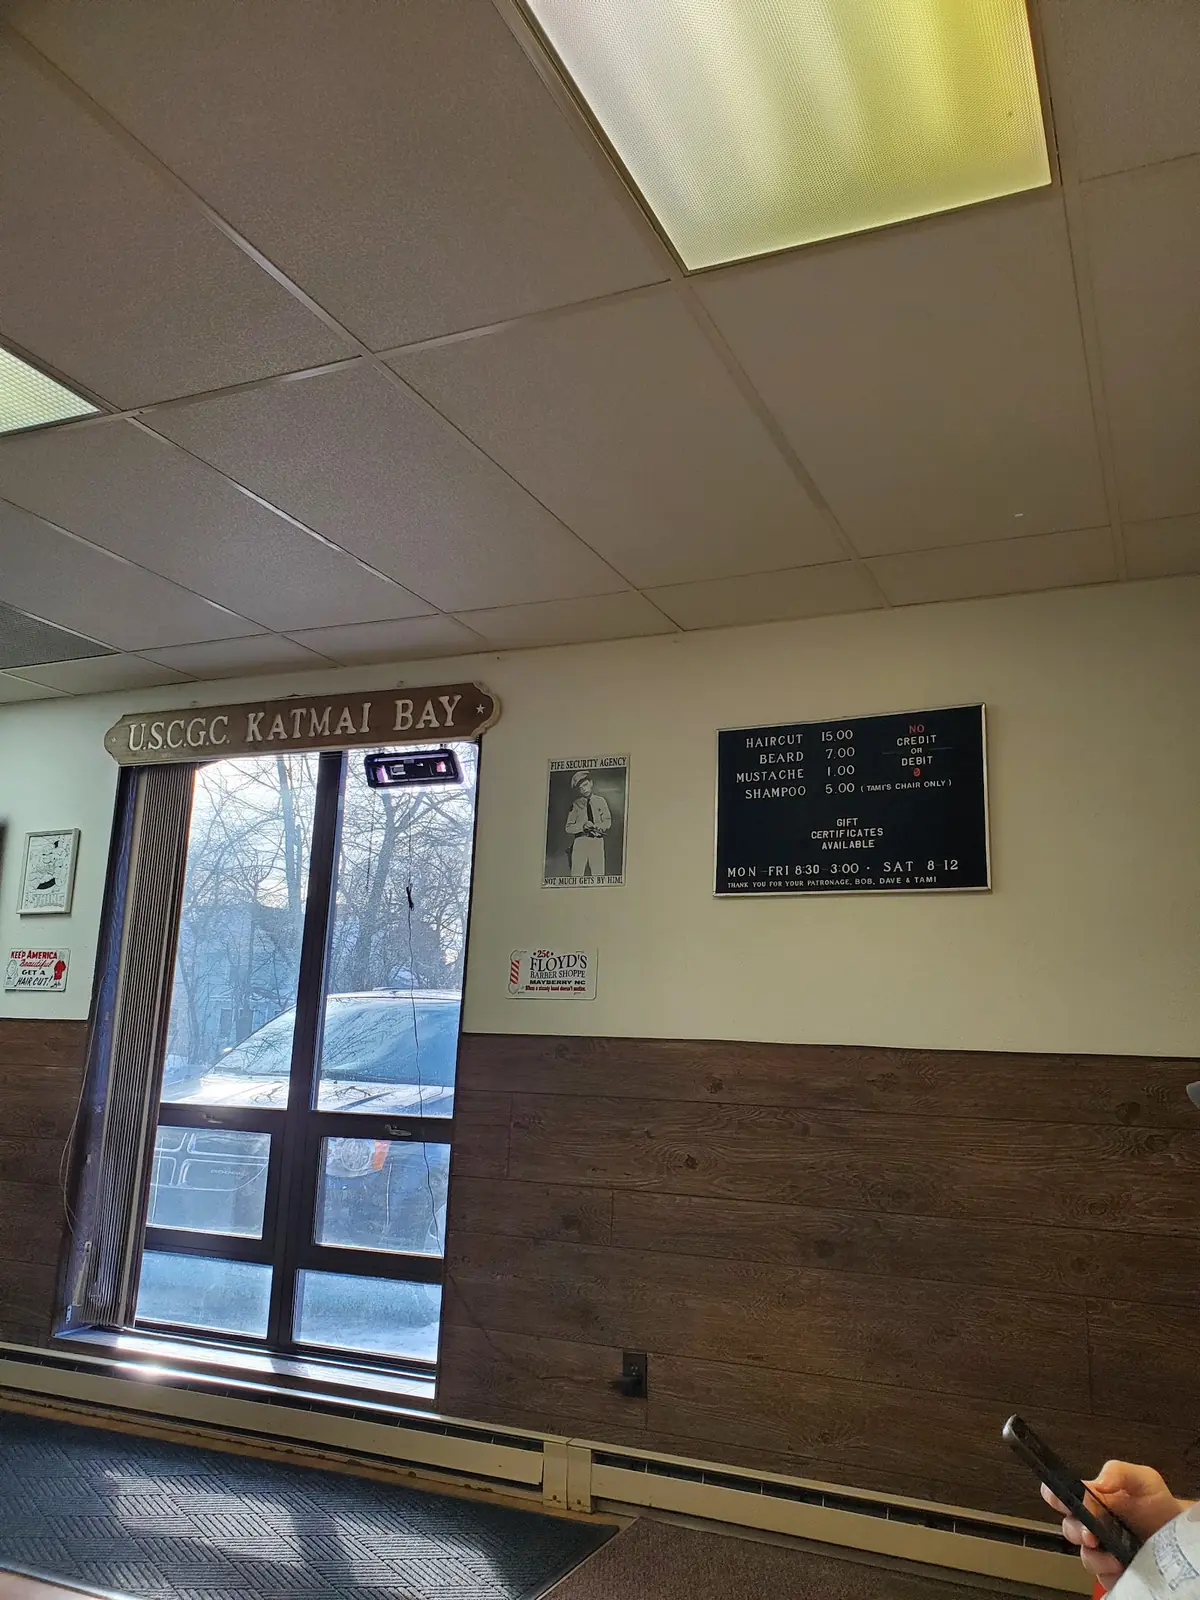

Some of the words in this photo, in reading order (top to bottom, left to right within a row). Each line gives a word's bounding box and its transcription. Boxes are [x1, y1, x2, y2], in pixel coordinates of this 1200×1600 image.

[245, 702, 372, 743] KATMAI
[392, 694, 462, 731] BAY
[908, 724, 925, 734] NO
[746, 734, 803, 748] HAIRCUT
[821, 729, 853, 742] 15.00
[896, 734, 937, 746] CREDIT
[759, 751, 804, 765] BEARD
[825, 747, 855, 759] 7.00
[910, 747, 923, 755] OR
[550, 761, 565, 770] FIFE
[565, 758, 599, 769] SECURITY
[600, 757, 627, 767] AGENCY
[901, 755, 933, 766] DEBIT
[736, 768, 804, 783] MUSTACHE
[827, 765, 855, 777] 1.00
[745, 785, 807, 799] SHAMPOO
[825, 782, 855, 794] 5.00
[895, 781, 921, 790] CHAIR
[836, 817, 858, 827] GIFT
[811, 827, 884, 839] CERTIFICATES
[821, 839, 875, 850] AVAILABLE
[883, 860, 914, 873] SAT
[544, 877, 557, 885] NOT
[558, 877, 577, 885] MUCH
[579, 876, 595, 884] GETS
[597, 876, 606, 884] BY
[727, 881, 749, 889] THANK
[879, 877, 902, 885] DAVE
[914, 876, 937, 884] TAMI
[10, 951, 26, 959] KEEP
[27, 950, 58, 959] AMERICA
[19, 959, 54, 970] Beautiful
[529, 954, 588, 972] FLOYD'S
[530, 970, 557, 979] BARBER
[558, 969, 586, 979] SHOPPE
